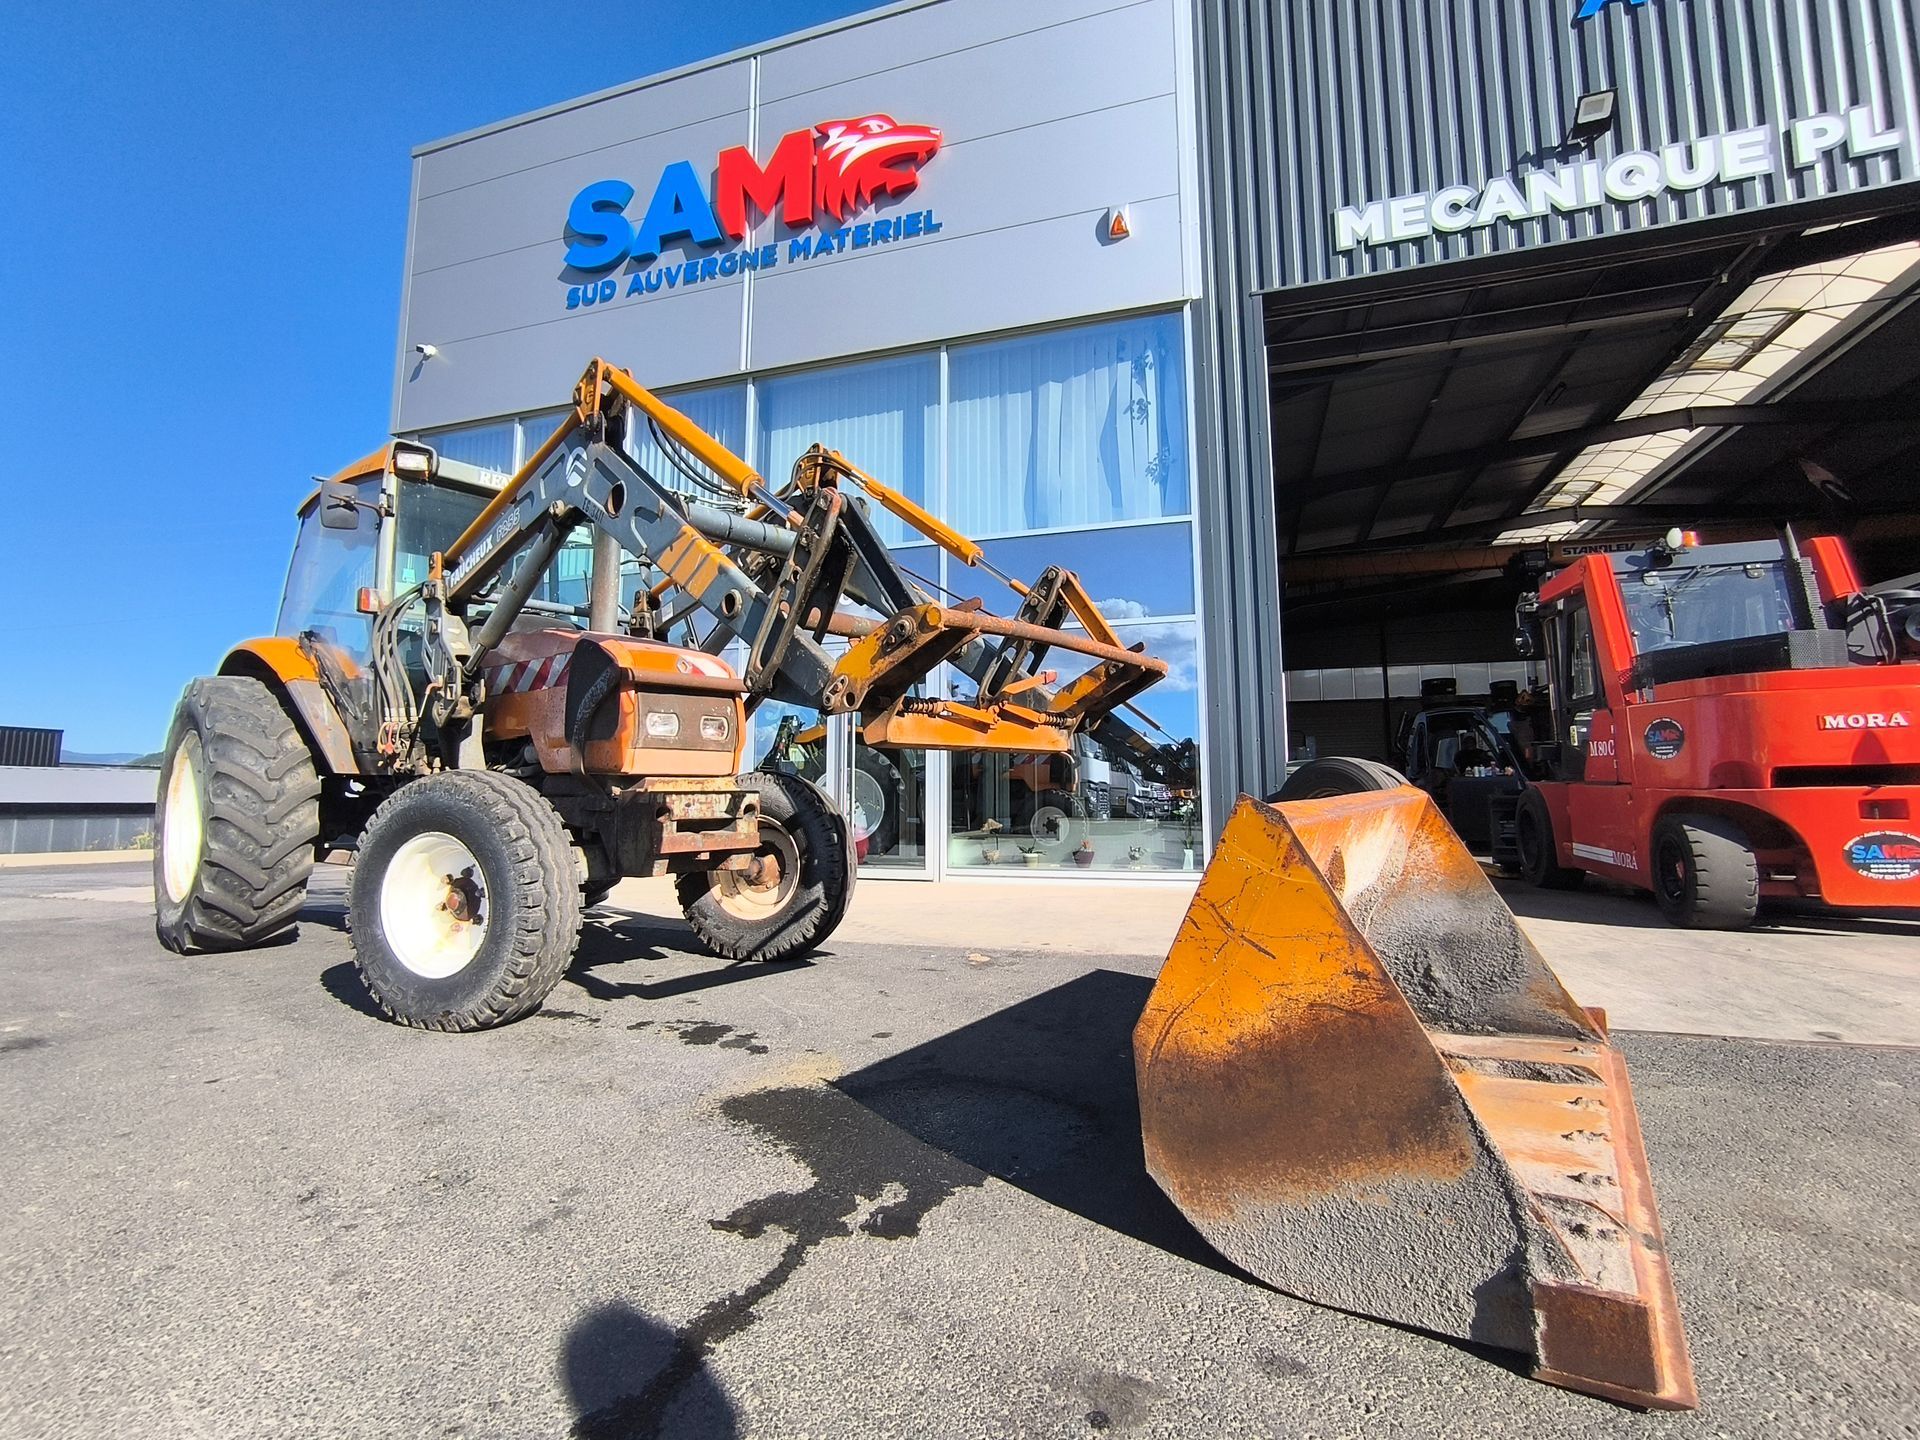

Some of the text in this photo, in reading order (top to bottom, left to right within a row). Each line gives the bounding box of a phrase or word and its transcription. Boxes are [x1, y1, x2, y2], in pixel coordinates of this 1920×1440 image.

[563, 128, 815, 273] SAM
[1333, 105, 1903, 251] MECANIQUE PL
[567, 209, 942, 309] SUD AUVERGNE MATERIEL
[450, 534, 493, 588] FAUCHEUX
[1823, 712, 1909, 729] MORA
